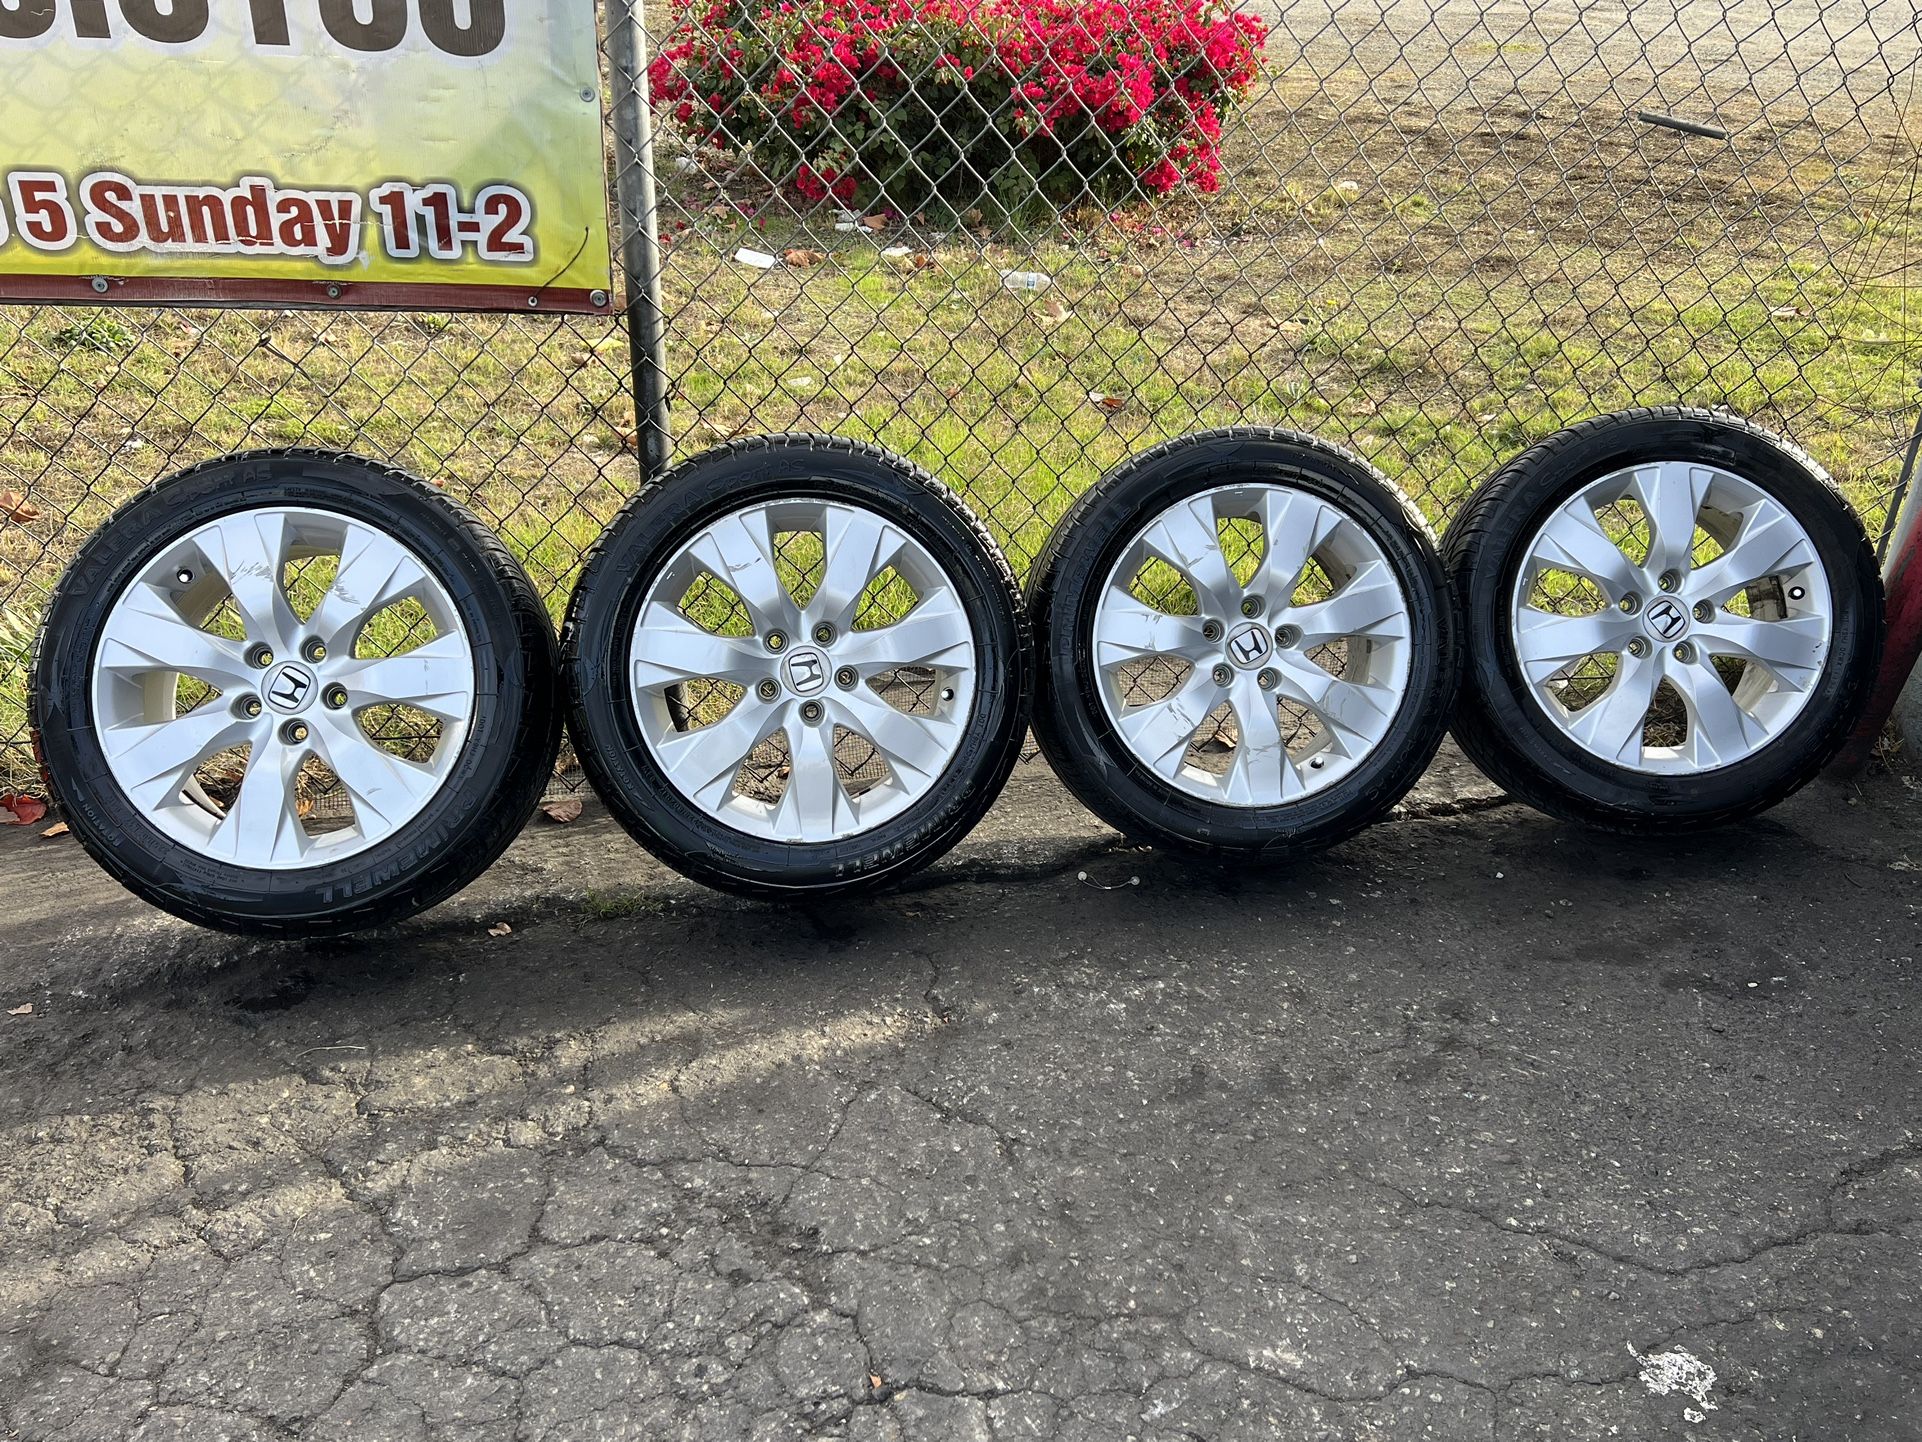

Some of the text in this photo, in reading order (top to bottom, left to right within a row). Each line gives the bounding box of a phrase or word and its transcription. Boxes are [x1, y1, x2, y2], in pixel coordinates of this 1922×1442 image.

[16, 178, 526, 257] 5 Sunday 11-2
[68, 500, 164, 602] VALERA
[81, 802, 121, 847] ROTATION
[314, 788, 481, 905] PRIMEWELL
